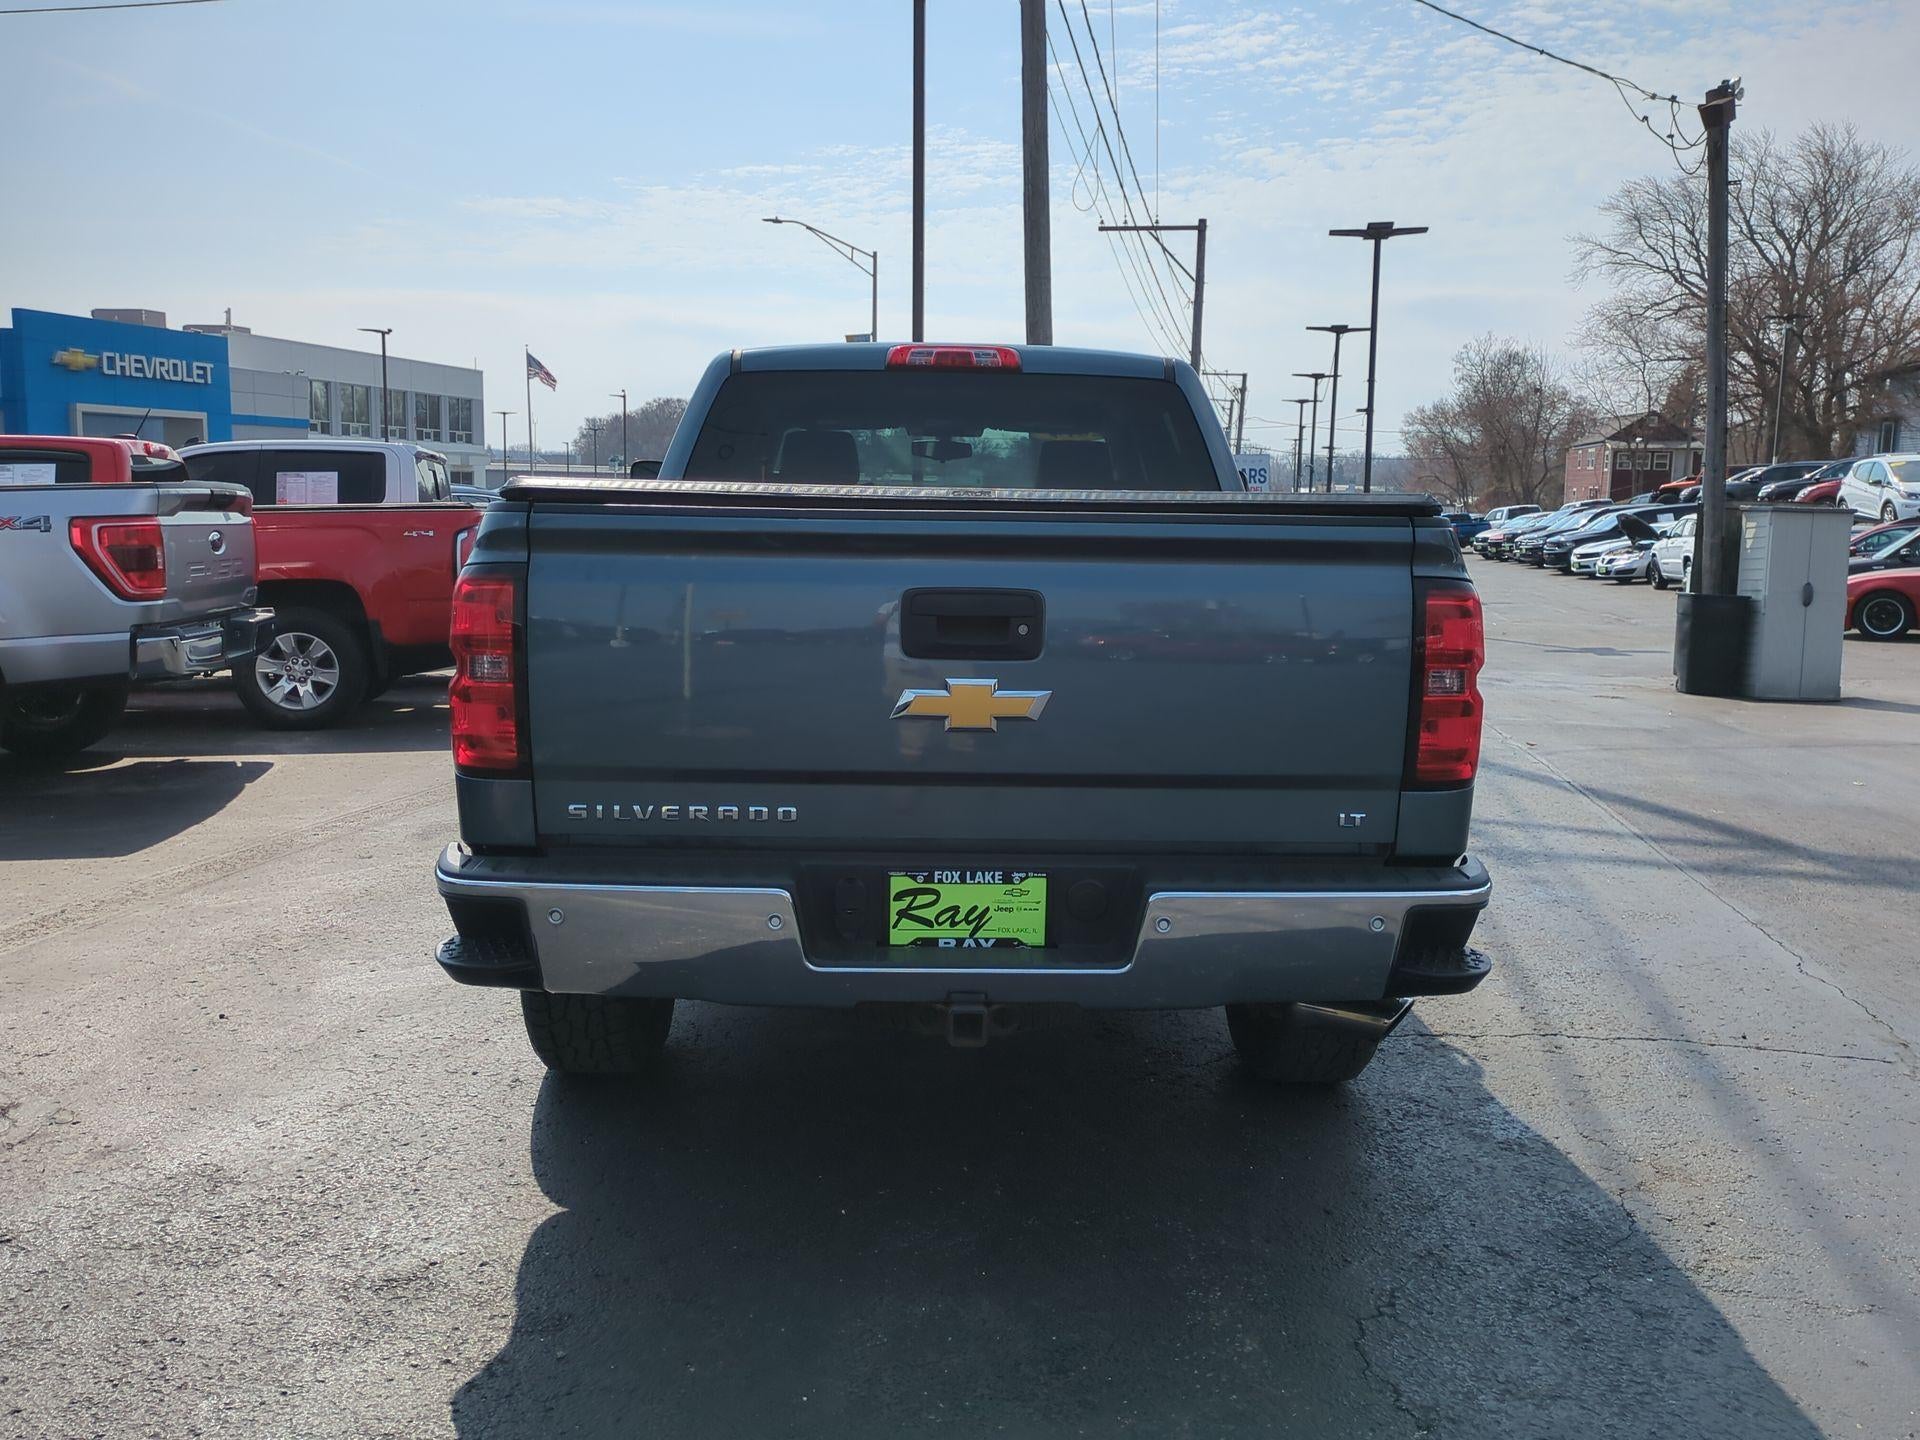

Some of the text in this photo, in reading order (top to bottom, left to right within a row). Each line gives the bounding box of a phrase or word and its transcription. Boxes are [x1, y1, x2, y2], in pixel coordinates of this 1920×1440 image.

[102, 351, 214, 384] CHEVROLET
[567, 804, 798, 823] SILVERADO
[1339, 813, 1366, 827] LT
[934, 871, 1003, 884] FOX LAKE
[892, 887, 992, 938] Ray
[994, 905, 1014, 914] Jeep
